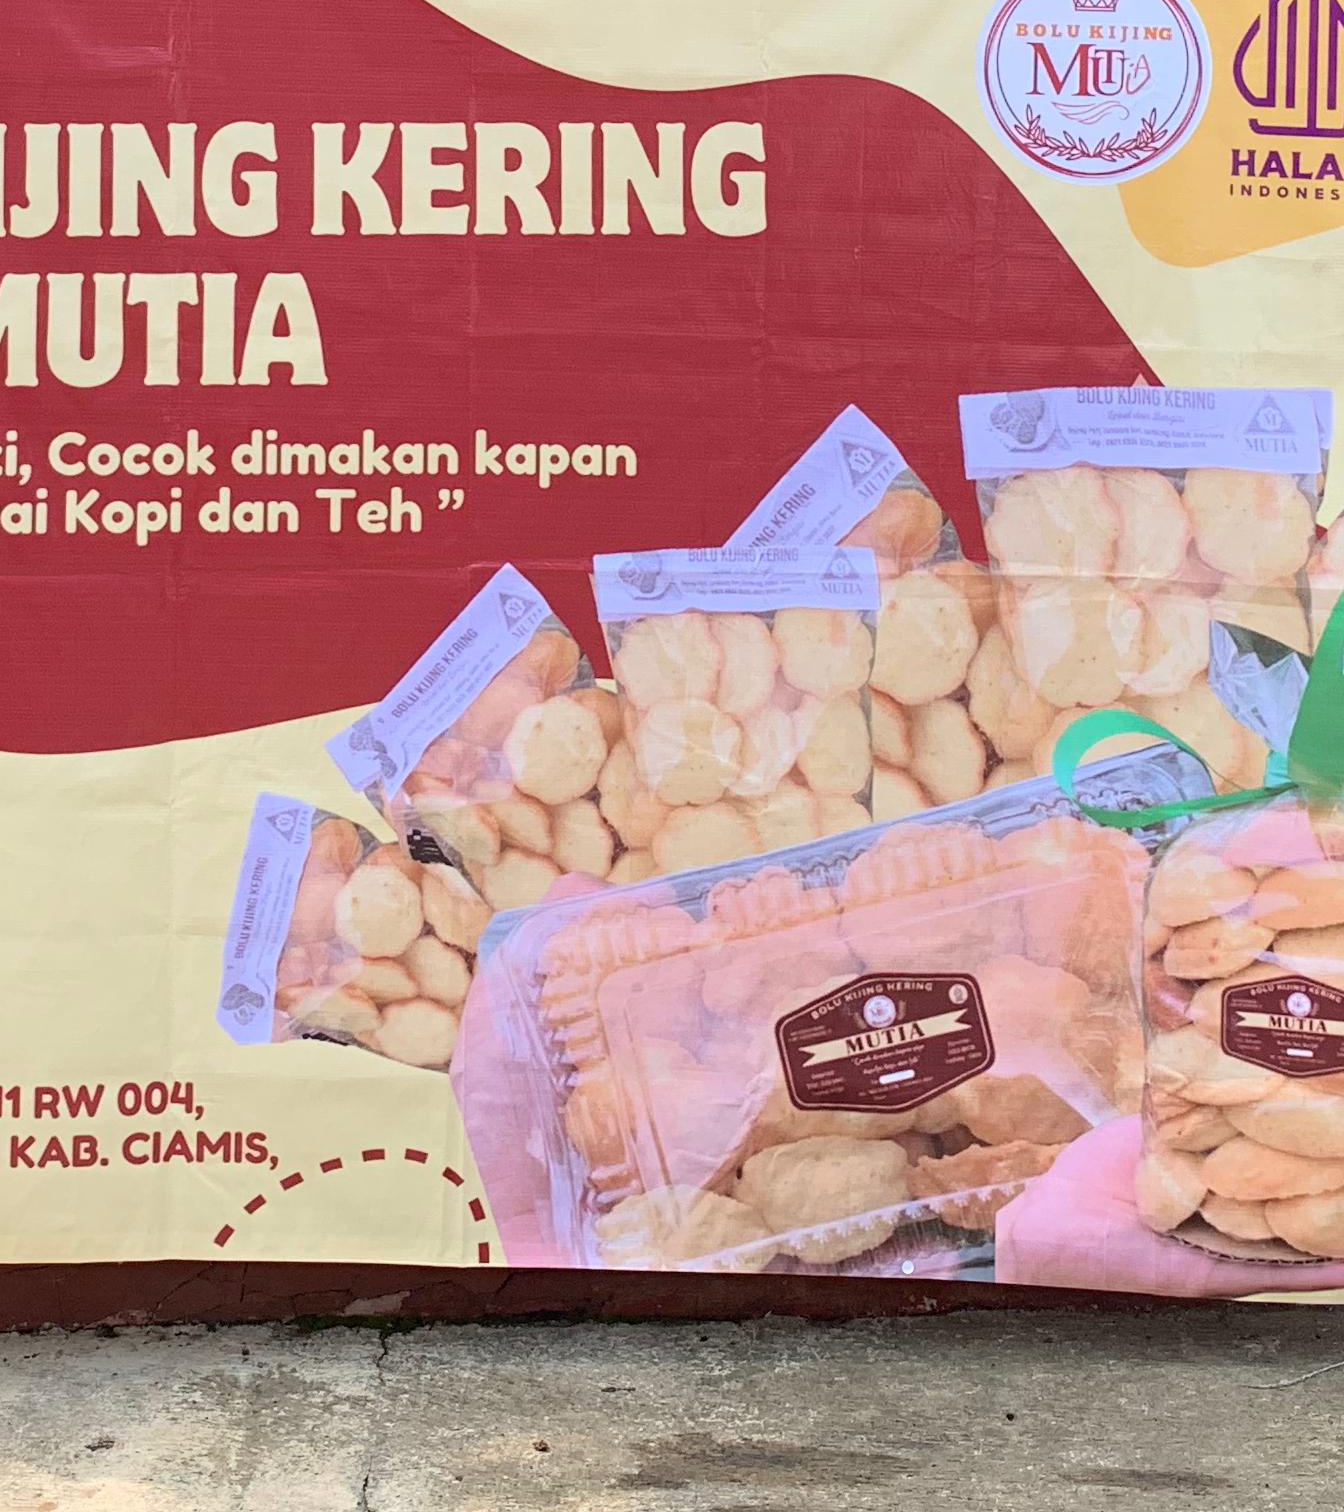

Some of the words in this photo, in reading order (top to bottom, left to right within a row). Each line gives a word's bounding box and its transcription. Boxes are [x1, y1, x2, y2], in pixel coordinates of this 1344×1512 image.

[1014, 21, 1082, 40] BOLU
[1088, 23, 1174, 42] KIJING
[311, 121, 767, 237] KERING
[1077, 387, 1113, 404] BOLU
[1164, 390, 1216, 411] KERING
[47, 429, 216, 479] Cocok
[229, 429, 459, 478] dimakan
[475, 429, 637, 489] kapan
[1244, 438, 1299, 454] MUTIA
[65, 487, 182, 546] Kopi
[198, 487, 299, 533] dan
[315, 487, 422, 533] Teh
[770, 483, 817, 530] KERING
[820, 581, 863, 596] MUTIA
[392, 694, 418, 719] BOLU
[443, 627, 479, 666] KERING
[810, 999, 843, 1021] BOLU
[887, 981, 934, 993] KERING
[845, 1023, 925, 1055] MUTIA
[1268, 1015, 1329, 1033] MUTIA
[34, 1085, 105, 1118] RW
[117, 1081, 205, 1120] 004,
[10, 1135, 108, 1168] KAB.
[121, 1131, 280, 1168] CIAMIS,
